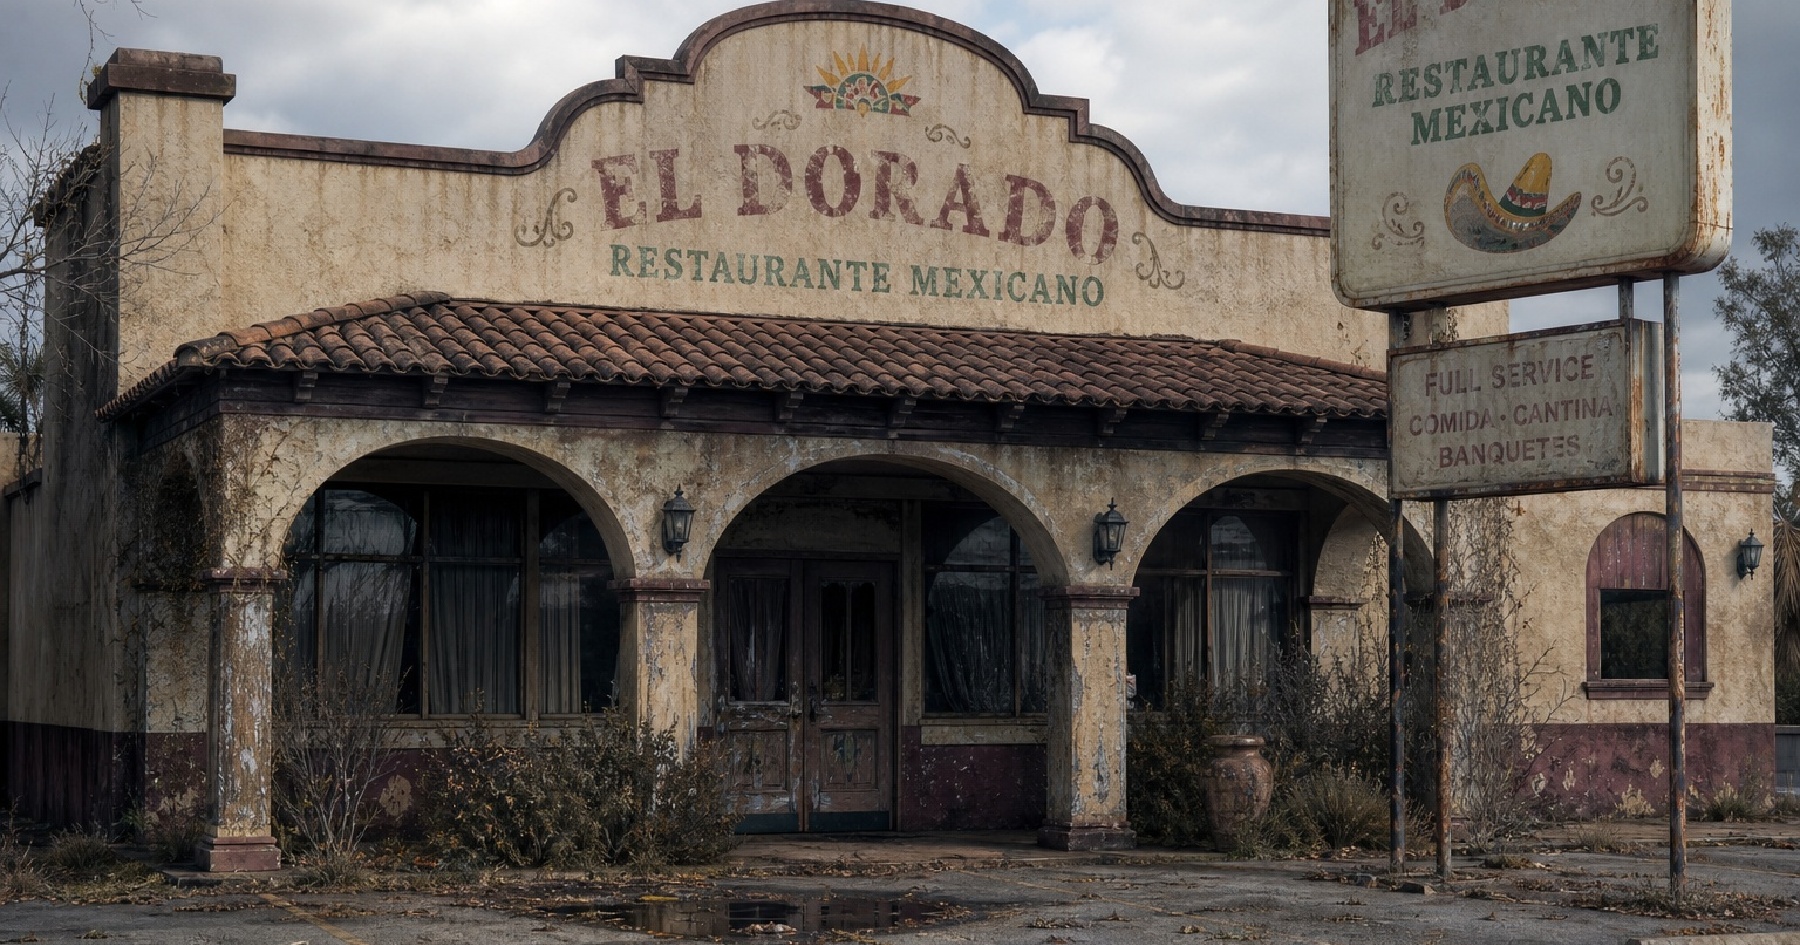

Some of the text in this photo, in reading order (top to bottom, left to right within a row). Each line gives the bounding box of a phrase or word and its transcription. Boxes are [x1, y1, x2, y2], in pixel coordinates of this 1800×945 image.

[1354, 0, 1418, 55] EL
[1372, 23, 1660, 108] RESTAURANTE
[1410, 77, 1622, 146] MEXICANO
[591, 143, 1119, 265] EL DORADO
[609, 244, 1105, 307] RESTAURANTE MEXICANO
[1425, 354, 1594, 396] FULL SERVICE
[1409, 408, 1495, 436] COMIDA
[1513, 395, 1613, 427] CANTINA
[1439, 434, 1581, 468] BANQUETES
